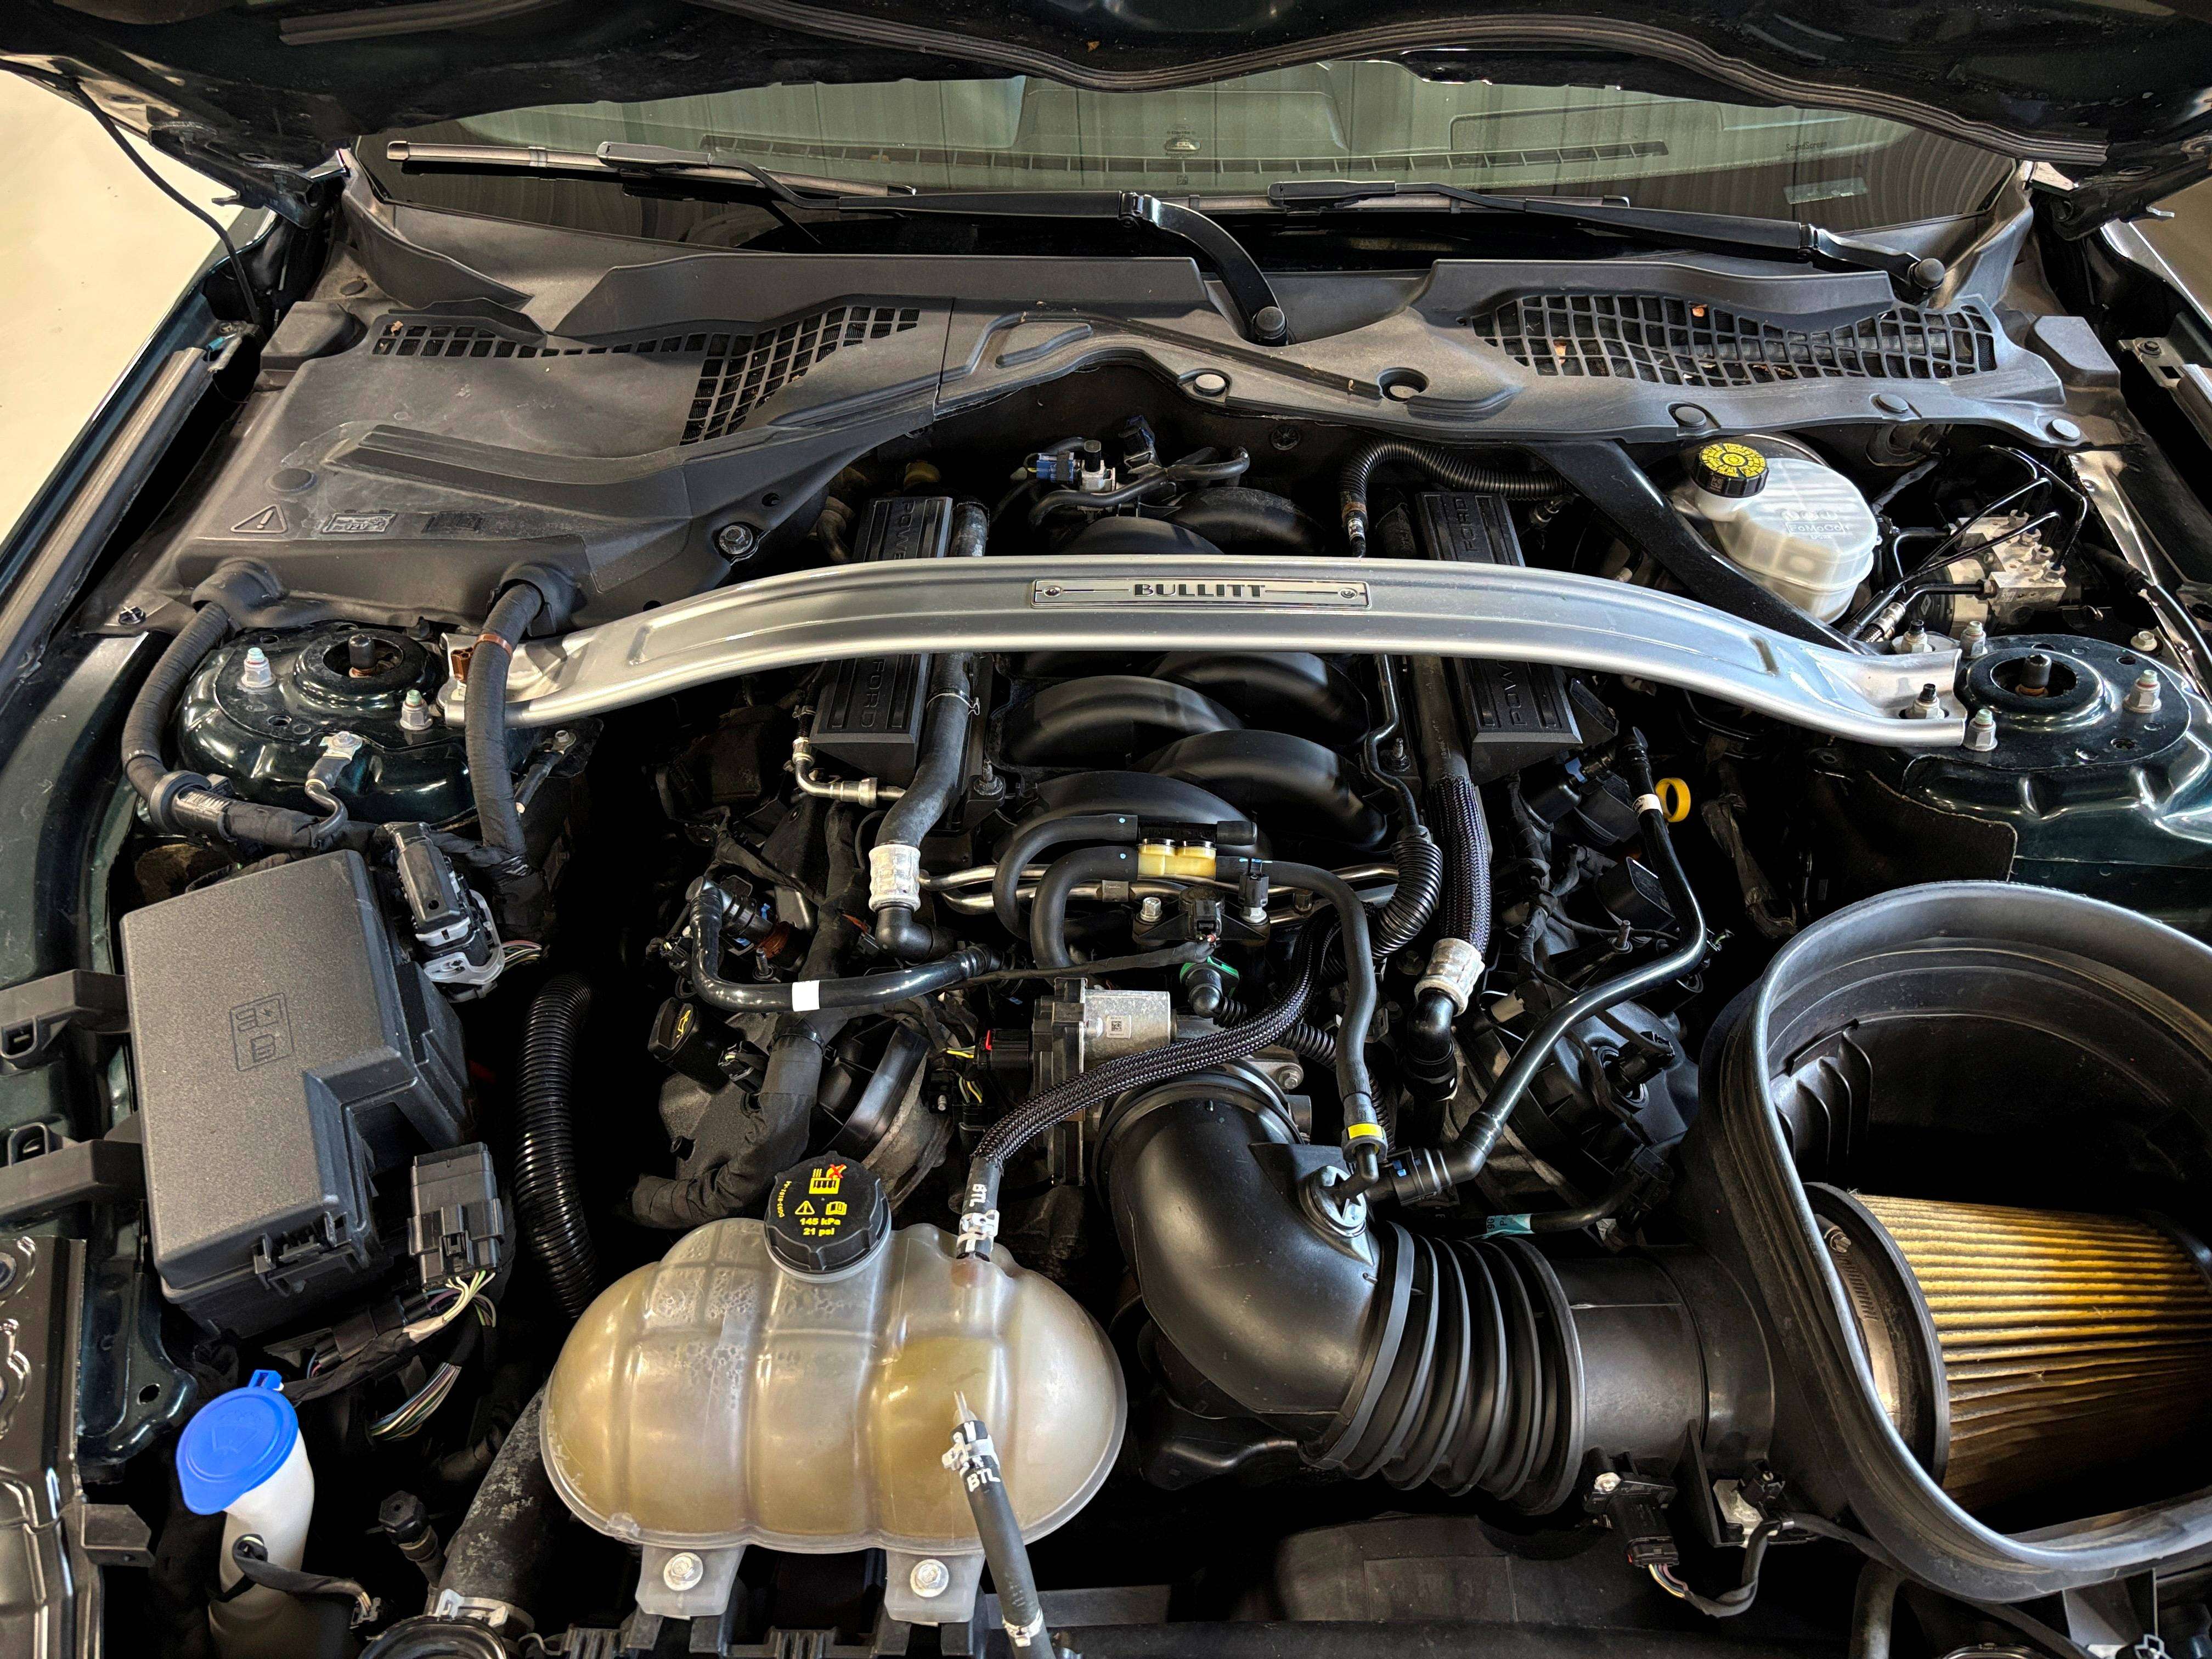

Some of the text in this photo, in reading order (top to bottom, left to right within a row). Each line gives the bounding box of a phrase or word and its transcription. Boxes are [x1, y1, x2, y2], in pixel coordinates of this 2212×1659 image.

[1786, 141, 1827, 151] SoundScreen
[1454, 498, 1479, 552] FORD
[1134, 584, 1266, 597] BULLITT
[861, 658, 886, 727] FORD
[799, 1217, 841, 1226] 145 kPa
[803, 1227, 835, 1237] 21 psi
